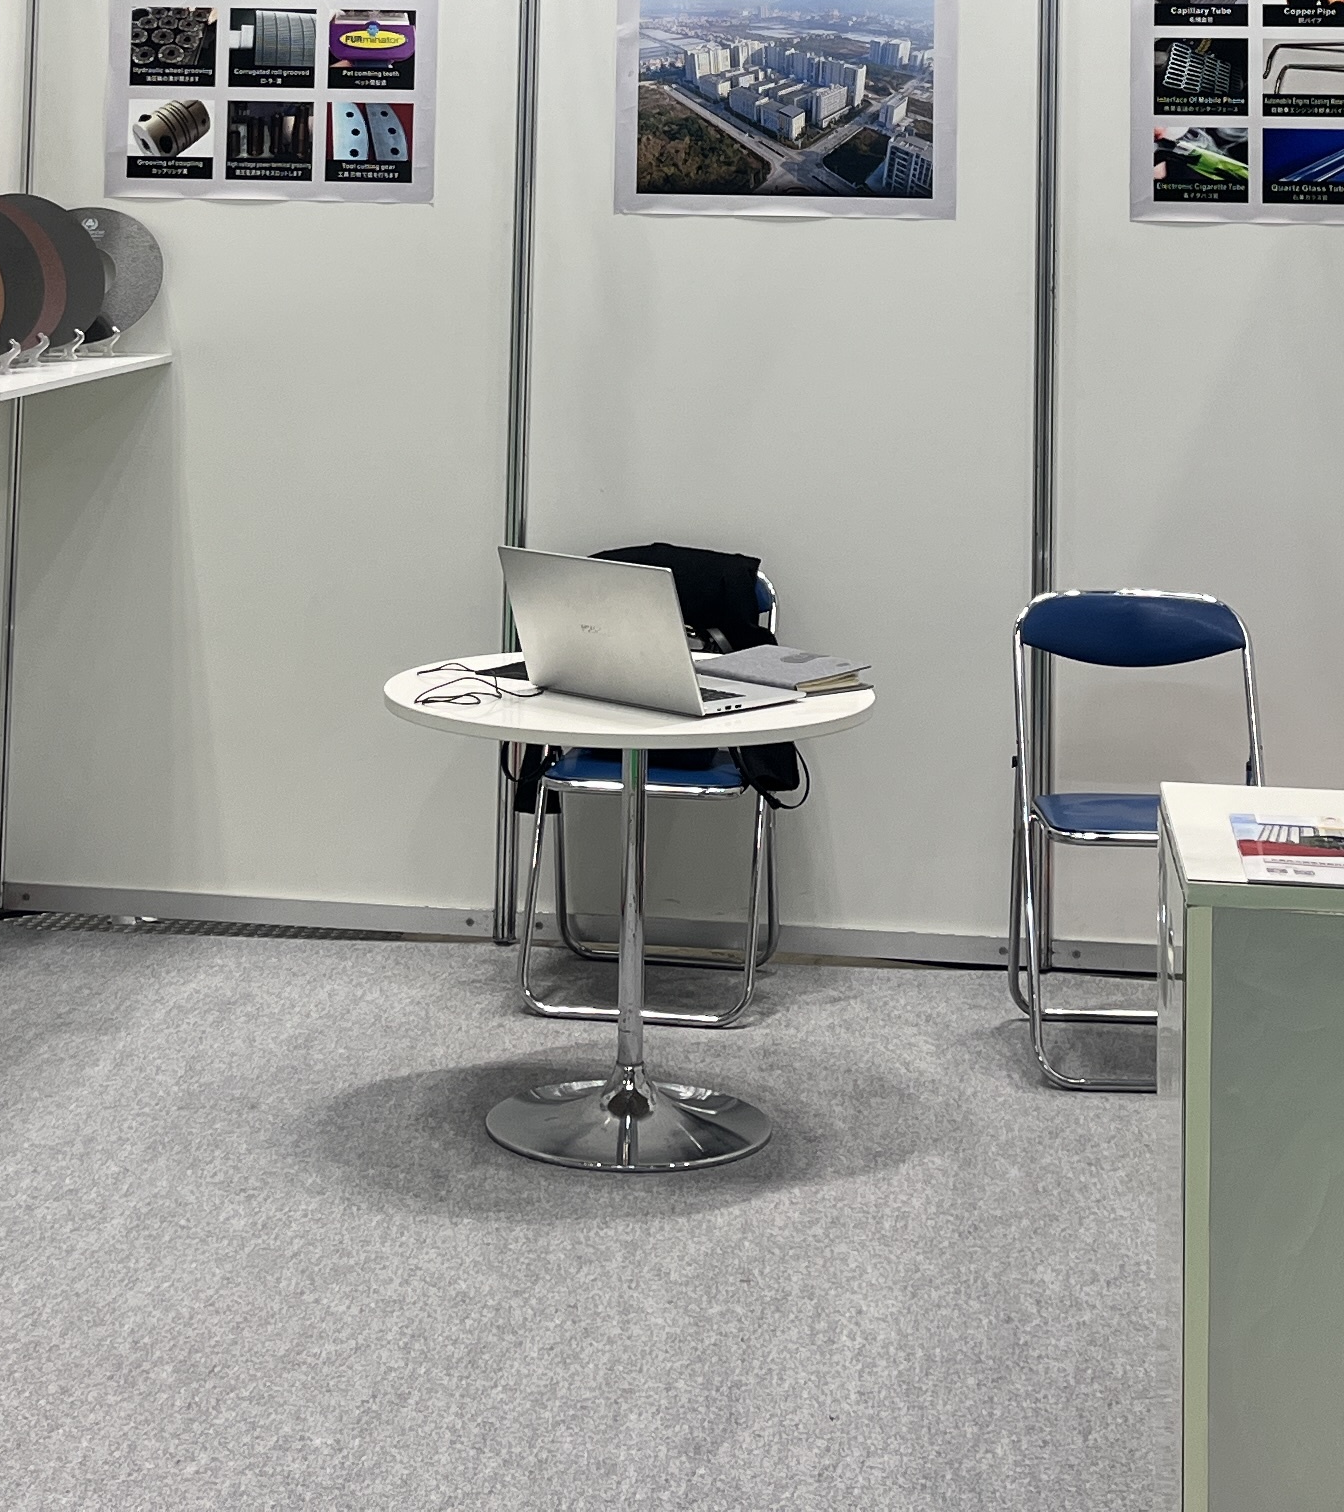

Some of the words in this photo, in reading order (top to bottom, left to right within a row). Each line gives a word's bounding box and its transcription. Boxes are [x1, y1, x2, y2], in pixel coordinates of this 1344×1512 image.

[1170, 7, 1209, 16] Capillary
[1284, 8, 1315, 16] Copper
[1317, 8, 1337, 16] Pipe
[1271, 184, 1300, 193] Quartz
[1302, 185, 1327, 193] Glass
